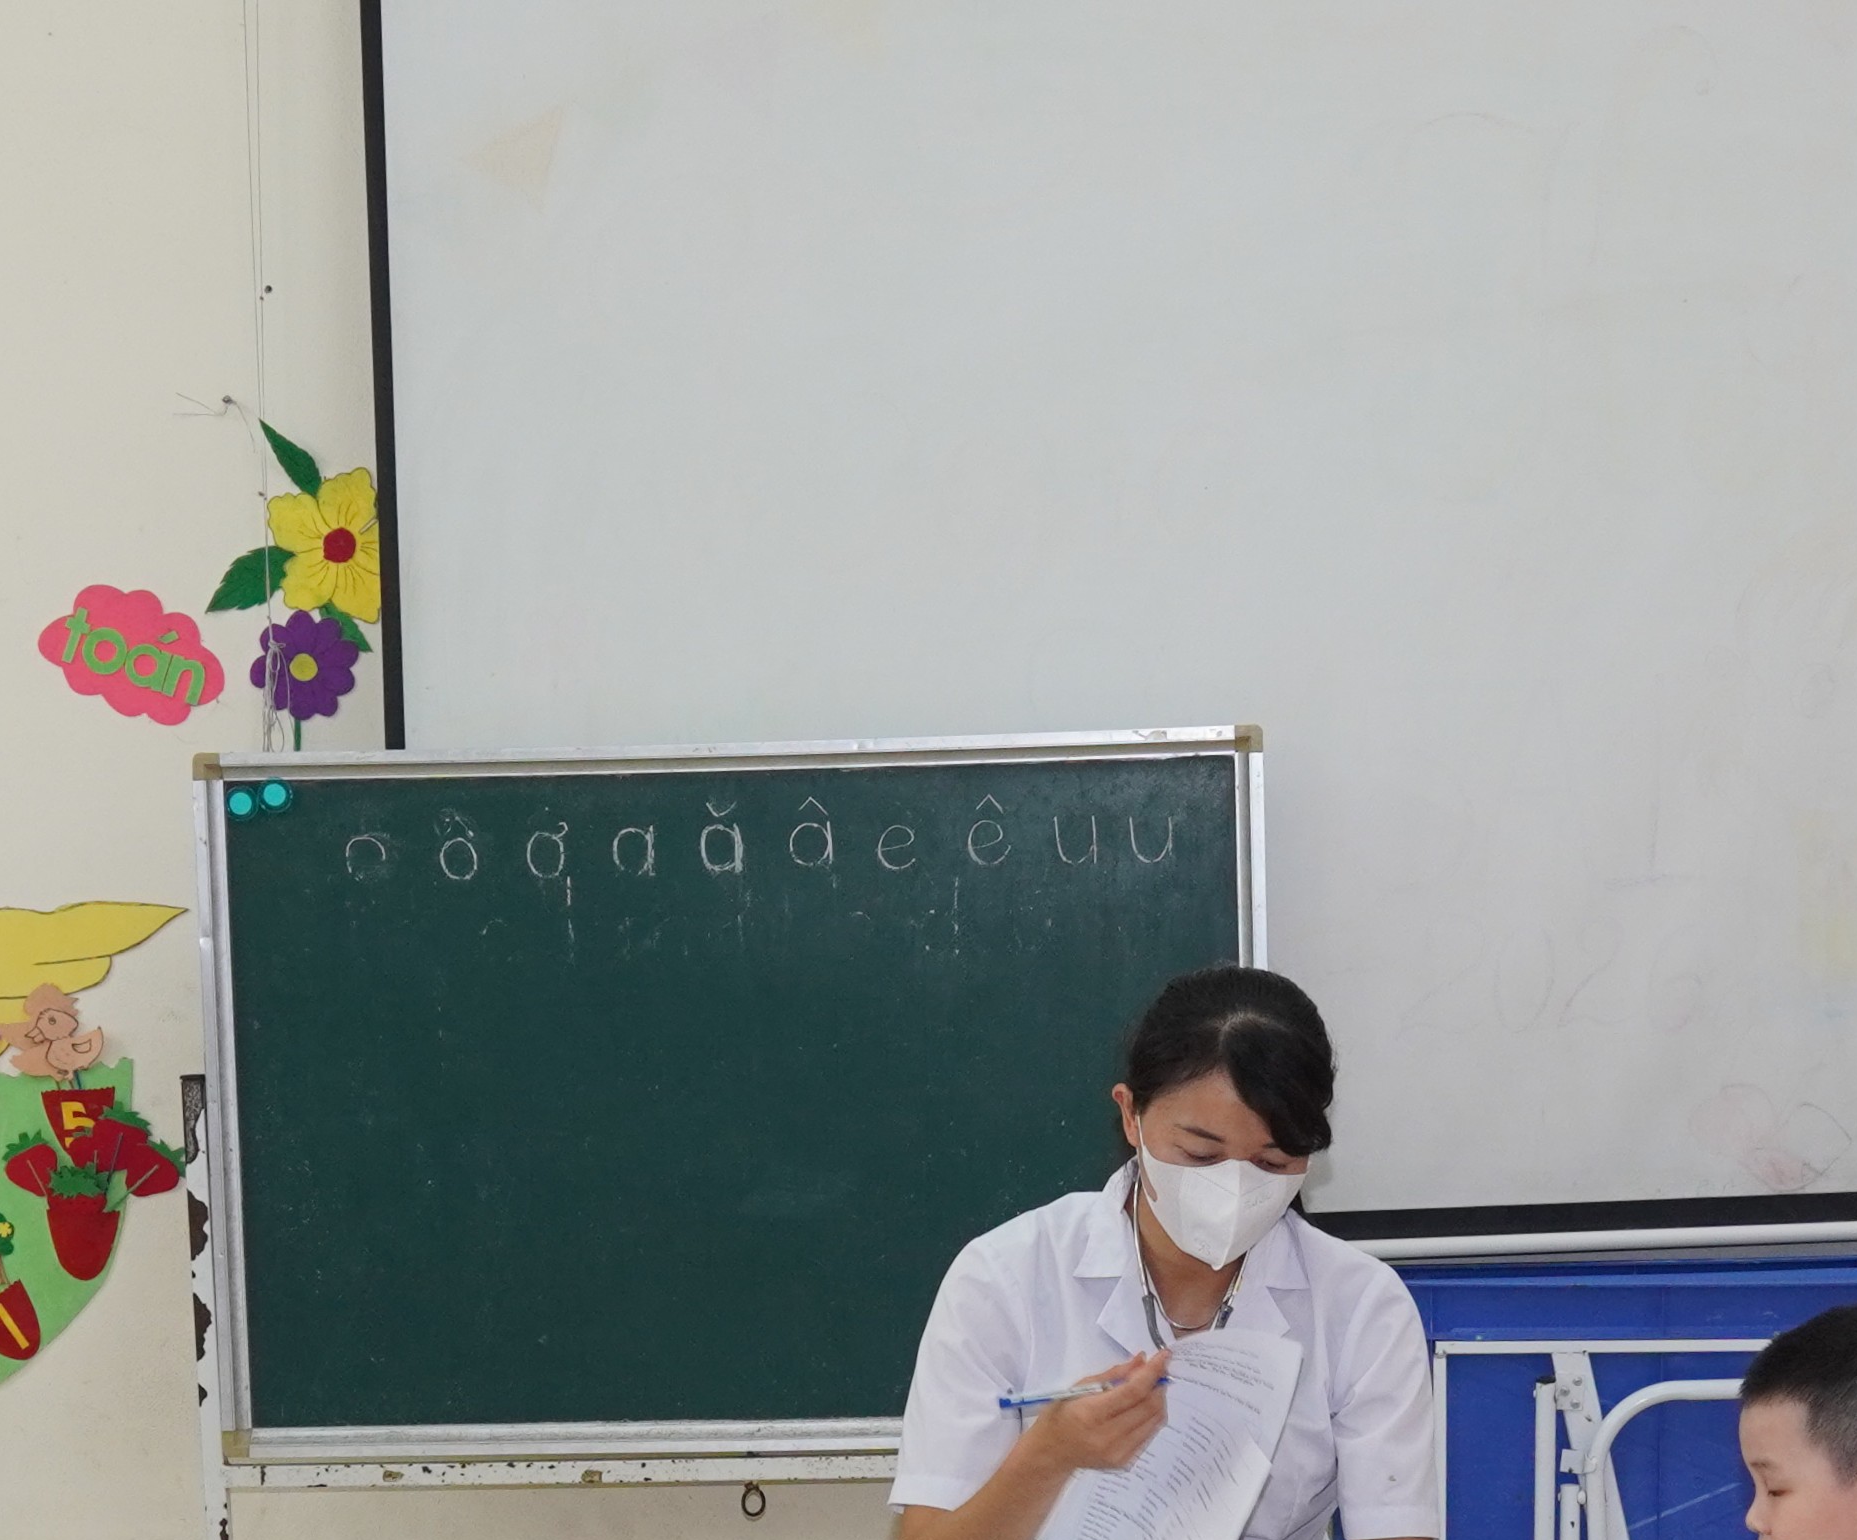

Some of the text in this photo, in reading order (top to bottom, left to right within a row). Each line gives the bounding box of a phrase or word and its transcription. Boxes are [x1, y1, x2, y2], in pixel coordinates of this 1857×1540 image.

[61, 607, 206, 706] toán
[613, 824, 655, 877] a
[700, 800, 742, 875] ă
[789, 796, 834, 868] â
[876, 824, 916, 870] e
[967, 794, 1012, 867] ê
[1054, 815, 1097, 865] u
